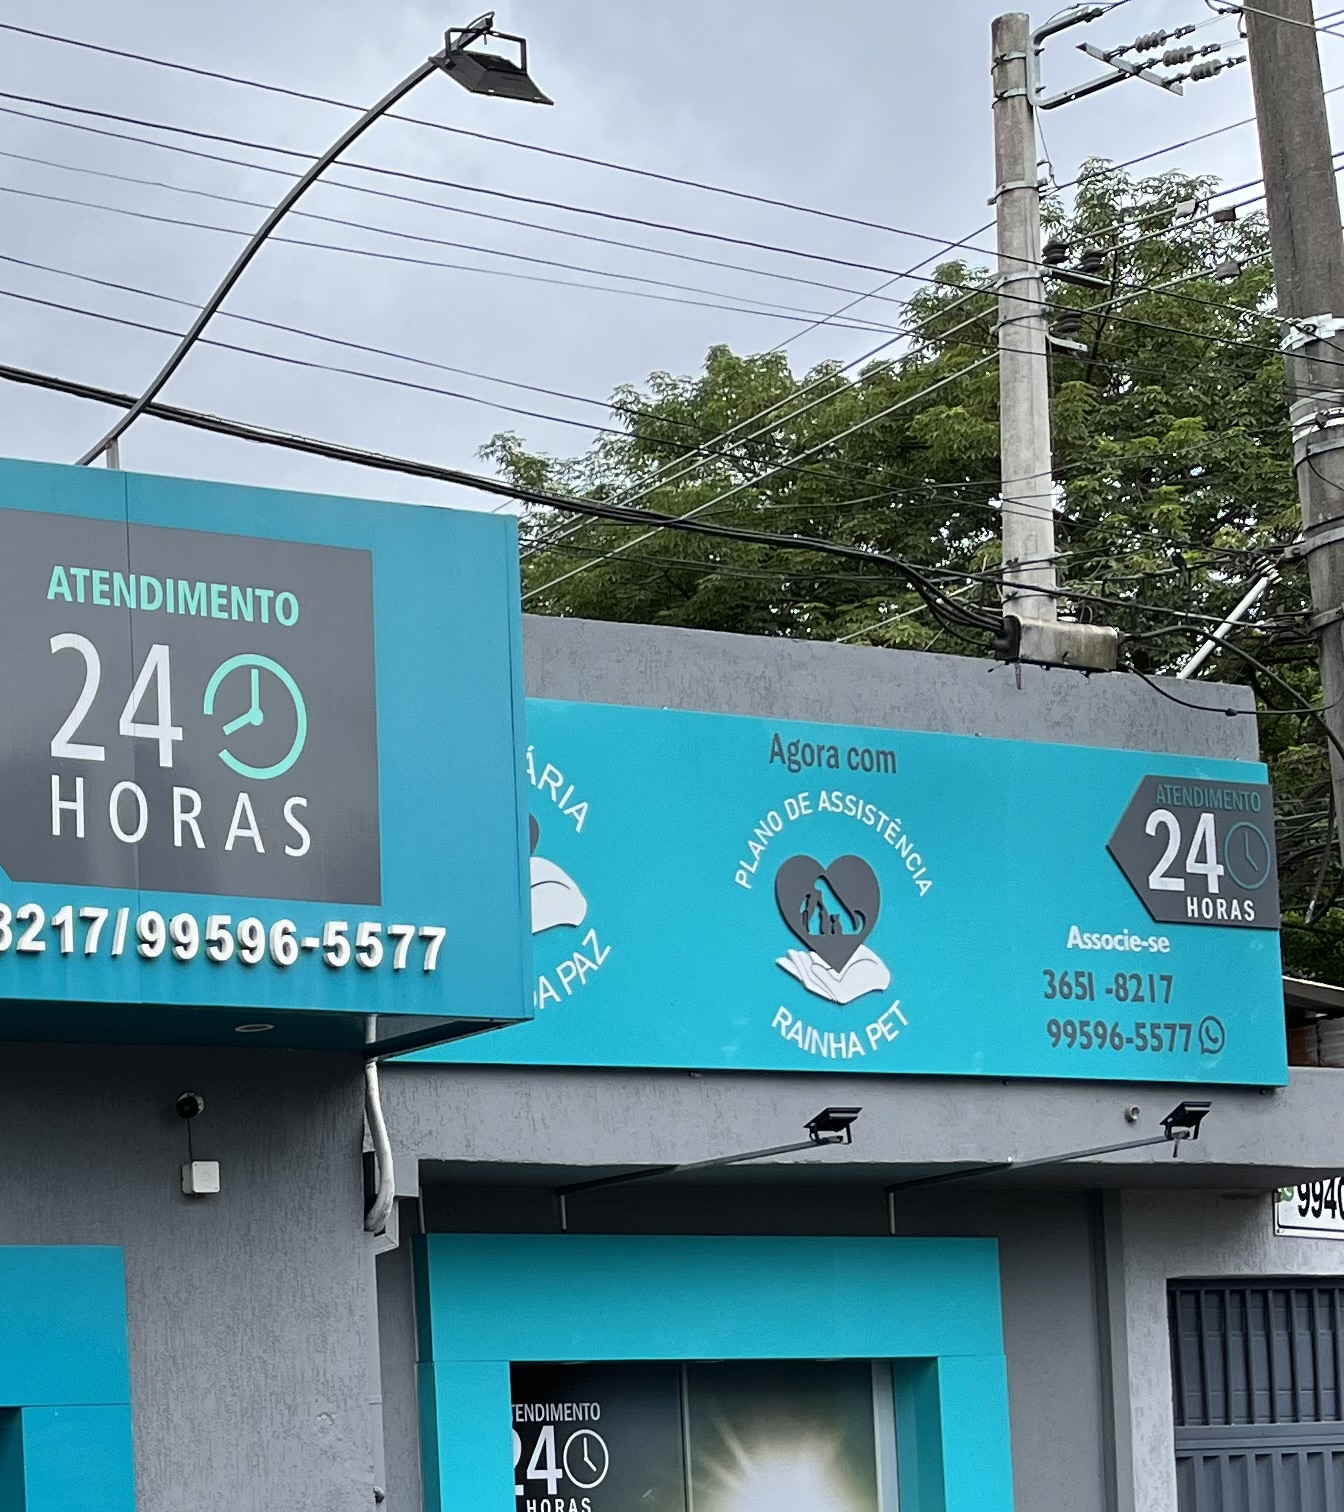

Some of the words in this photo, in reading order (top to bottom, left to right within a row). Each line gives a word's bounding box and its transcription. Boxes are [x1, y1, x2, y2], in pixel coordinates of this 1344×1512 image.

[46, 566, 300, 627] ATENDIMENTO
[48, 633, 183, 769] 24
[769, 733, 840, 774] Agora
[847, 747, 898, 774] com
[51, 775, 312, 857] HORAS
[1156, 784, 1261, 813] ATENDIMENTO
[735, 811, 783, 889] PLANO
[784, 792, 813, 821] DE
[818, 790, 933, 896] ASSISTÊNCIA
[1145, 809, 1225, 894] 24
[1186, 896, 1255, 922] HORAS
[1067, 925, 1171, 953] Associe-se
[533, 975, 561, 1009] A
[556, 928, 612, 995] PAZ
[1043, 969, 1095, 1001] 3651
[772, 1006, 865, 1060] RAINHA
[866, 1000, 909, 1050] PET
[1047, 1018, 1192, 1053] 99596-5577
[512, 1402, 601, 1422] ENDIMENTO
